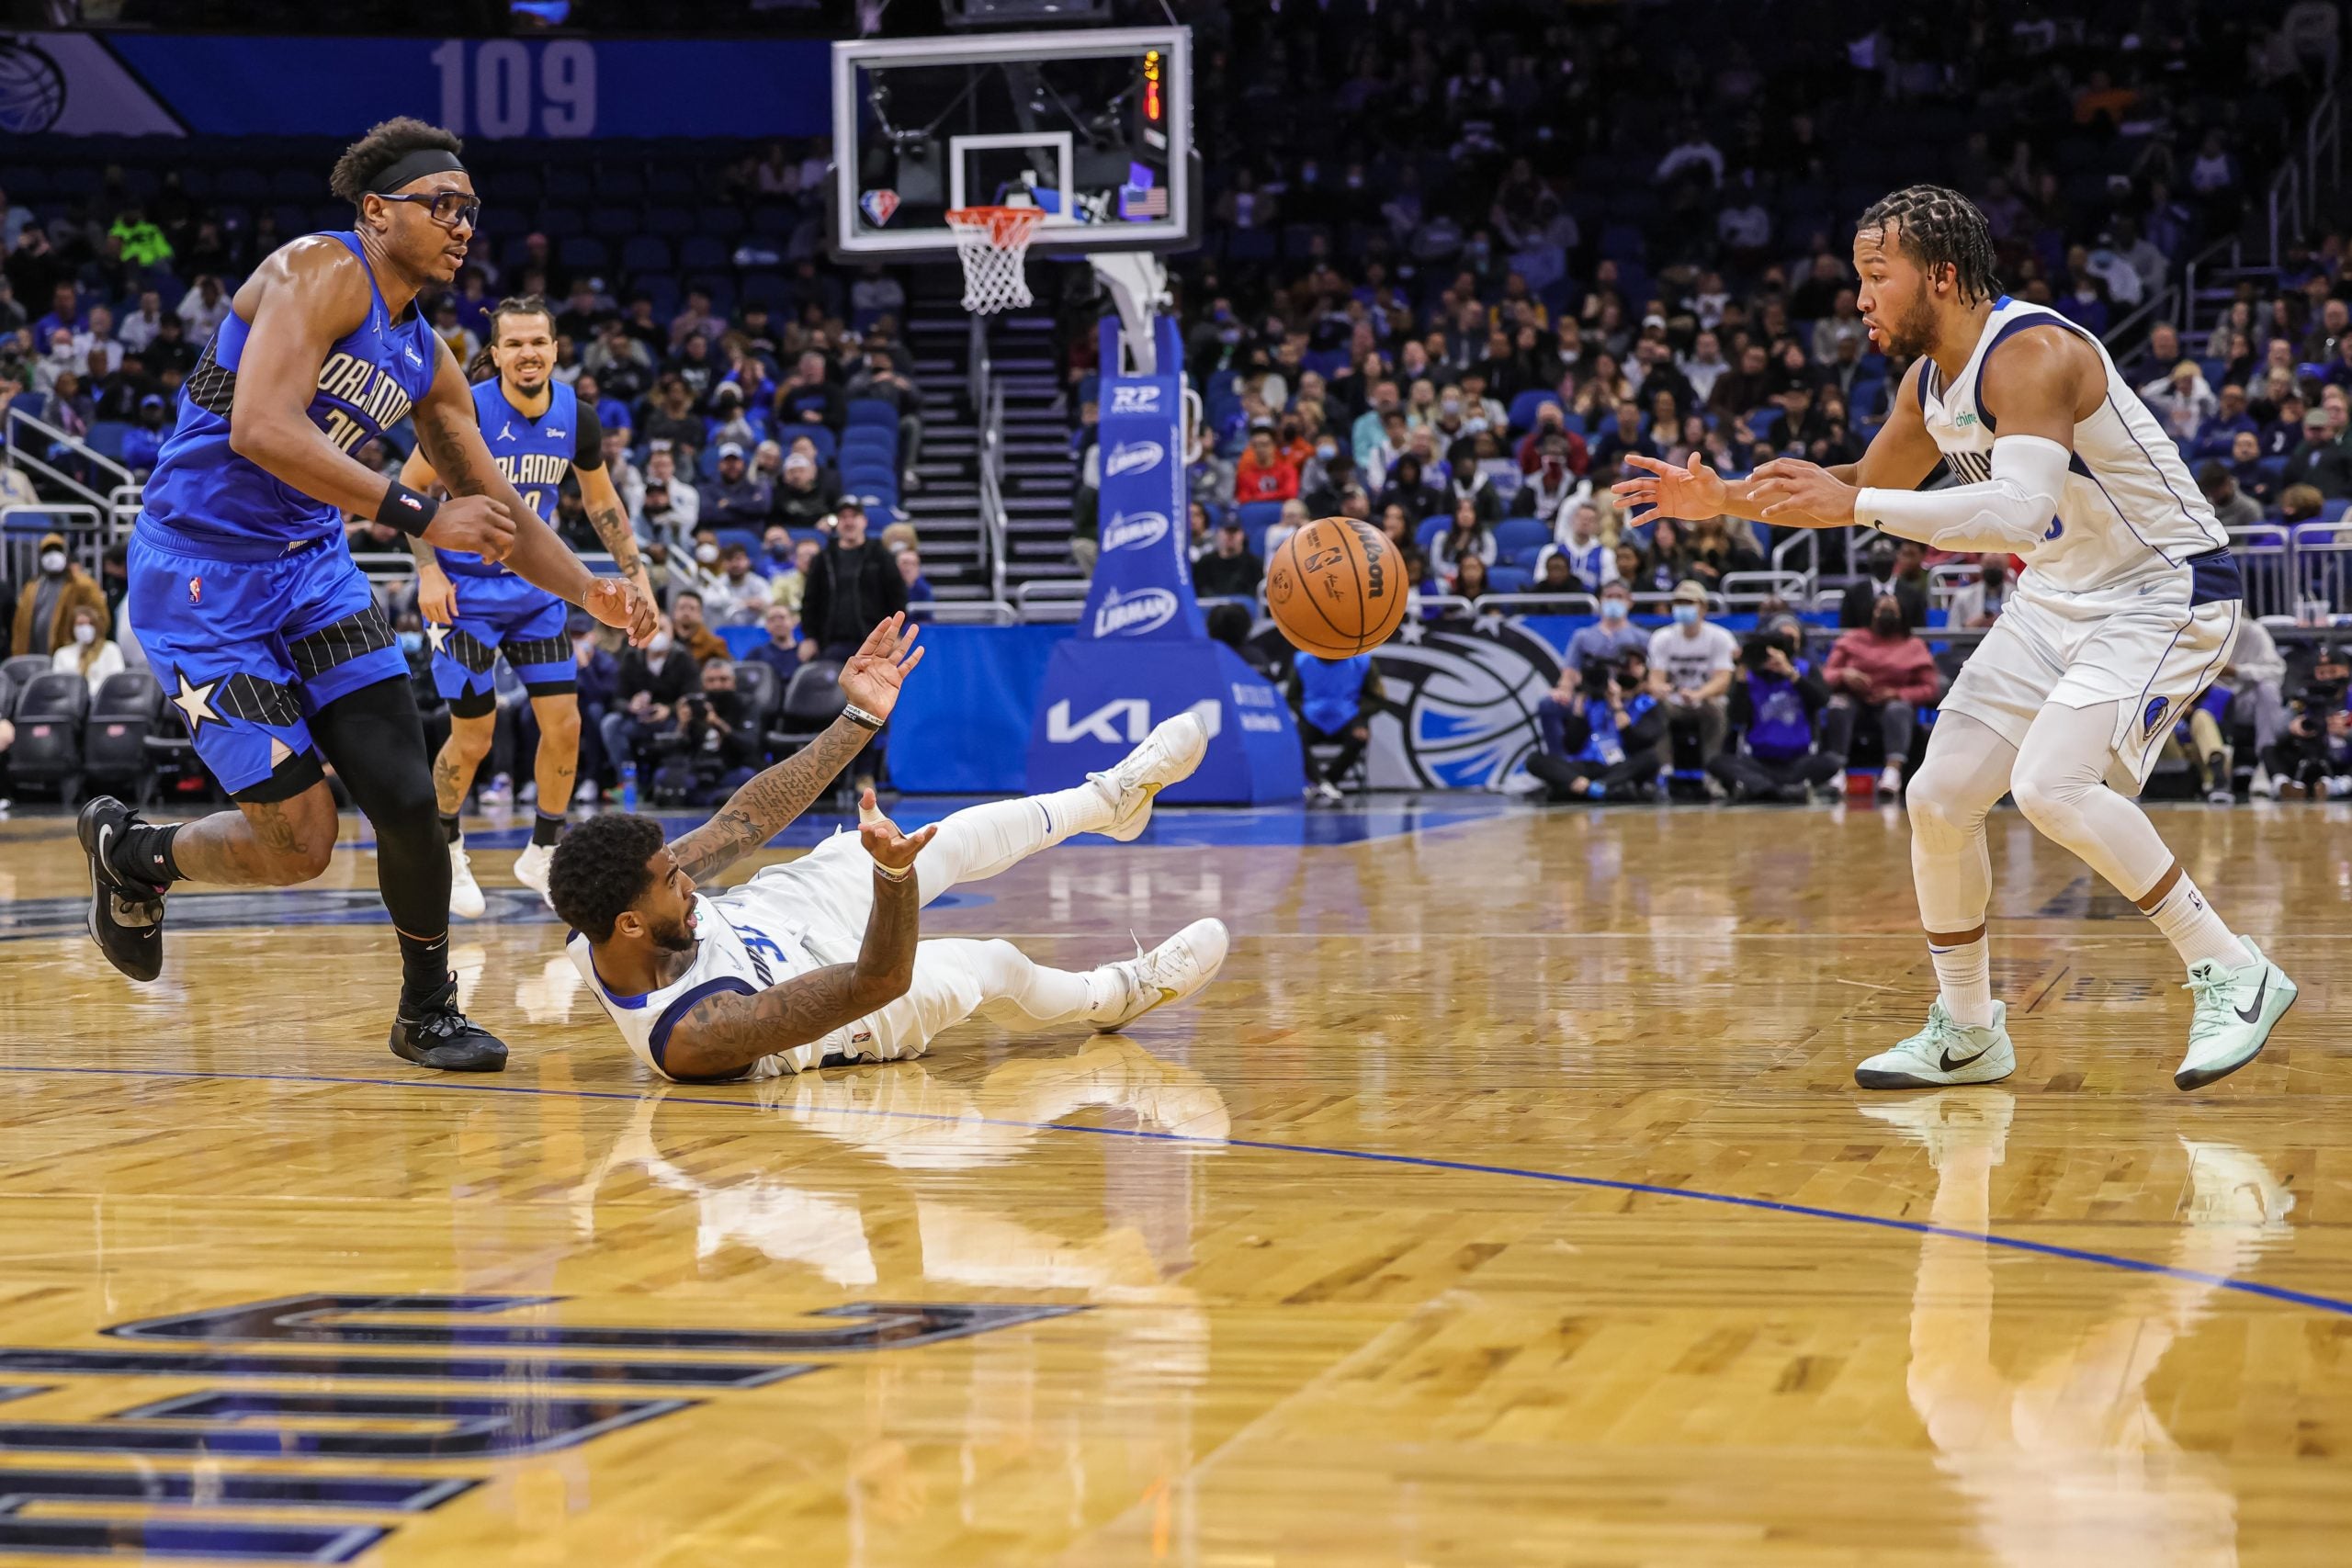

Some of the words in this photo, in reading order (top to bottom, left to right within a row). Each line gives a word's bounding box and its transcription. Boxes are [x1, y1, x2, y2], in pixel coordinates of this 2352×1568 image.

[430, 39, 596, 140] 109
[317, 352, 412, 431] ORLANDO
[1345, 519, 1384, 600] Wilson
